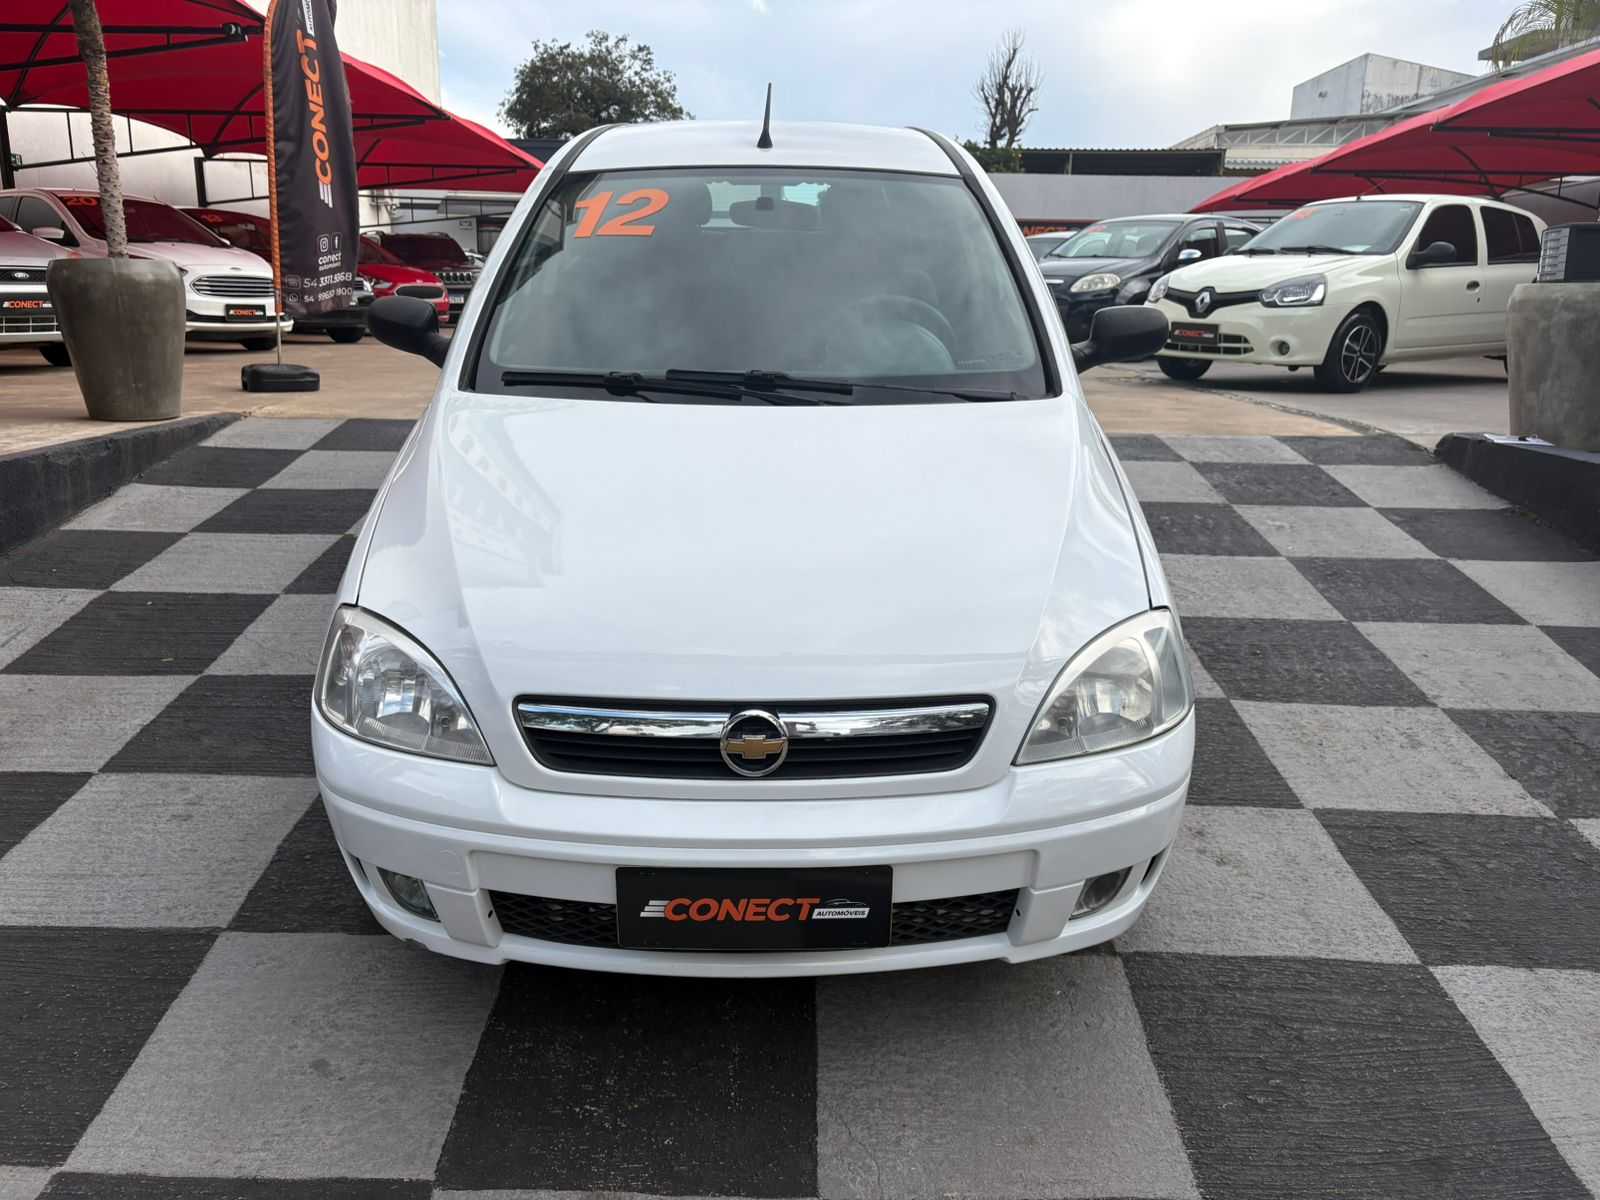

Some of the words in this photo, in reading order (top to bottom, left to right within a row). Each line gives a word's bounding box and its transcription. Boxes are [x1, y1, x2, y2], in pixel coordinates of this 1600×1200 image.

[296, 29, 333, 185] CONECT
[575, 188, 670, 238] 12
[9, 300, 44, 309] CONECT
[664, 898, 820, 922] CONECT
[816, 909, 866, 917] AUTOMÓVEIS
